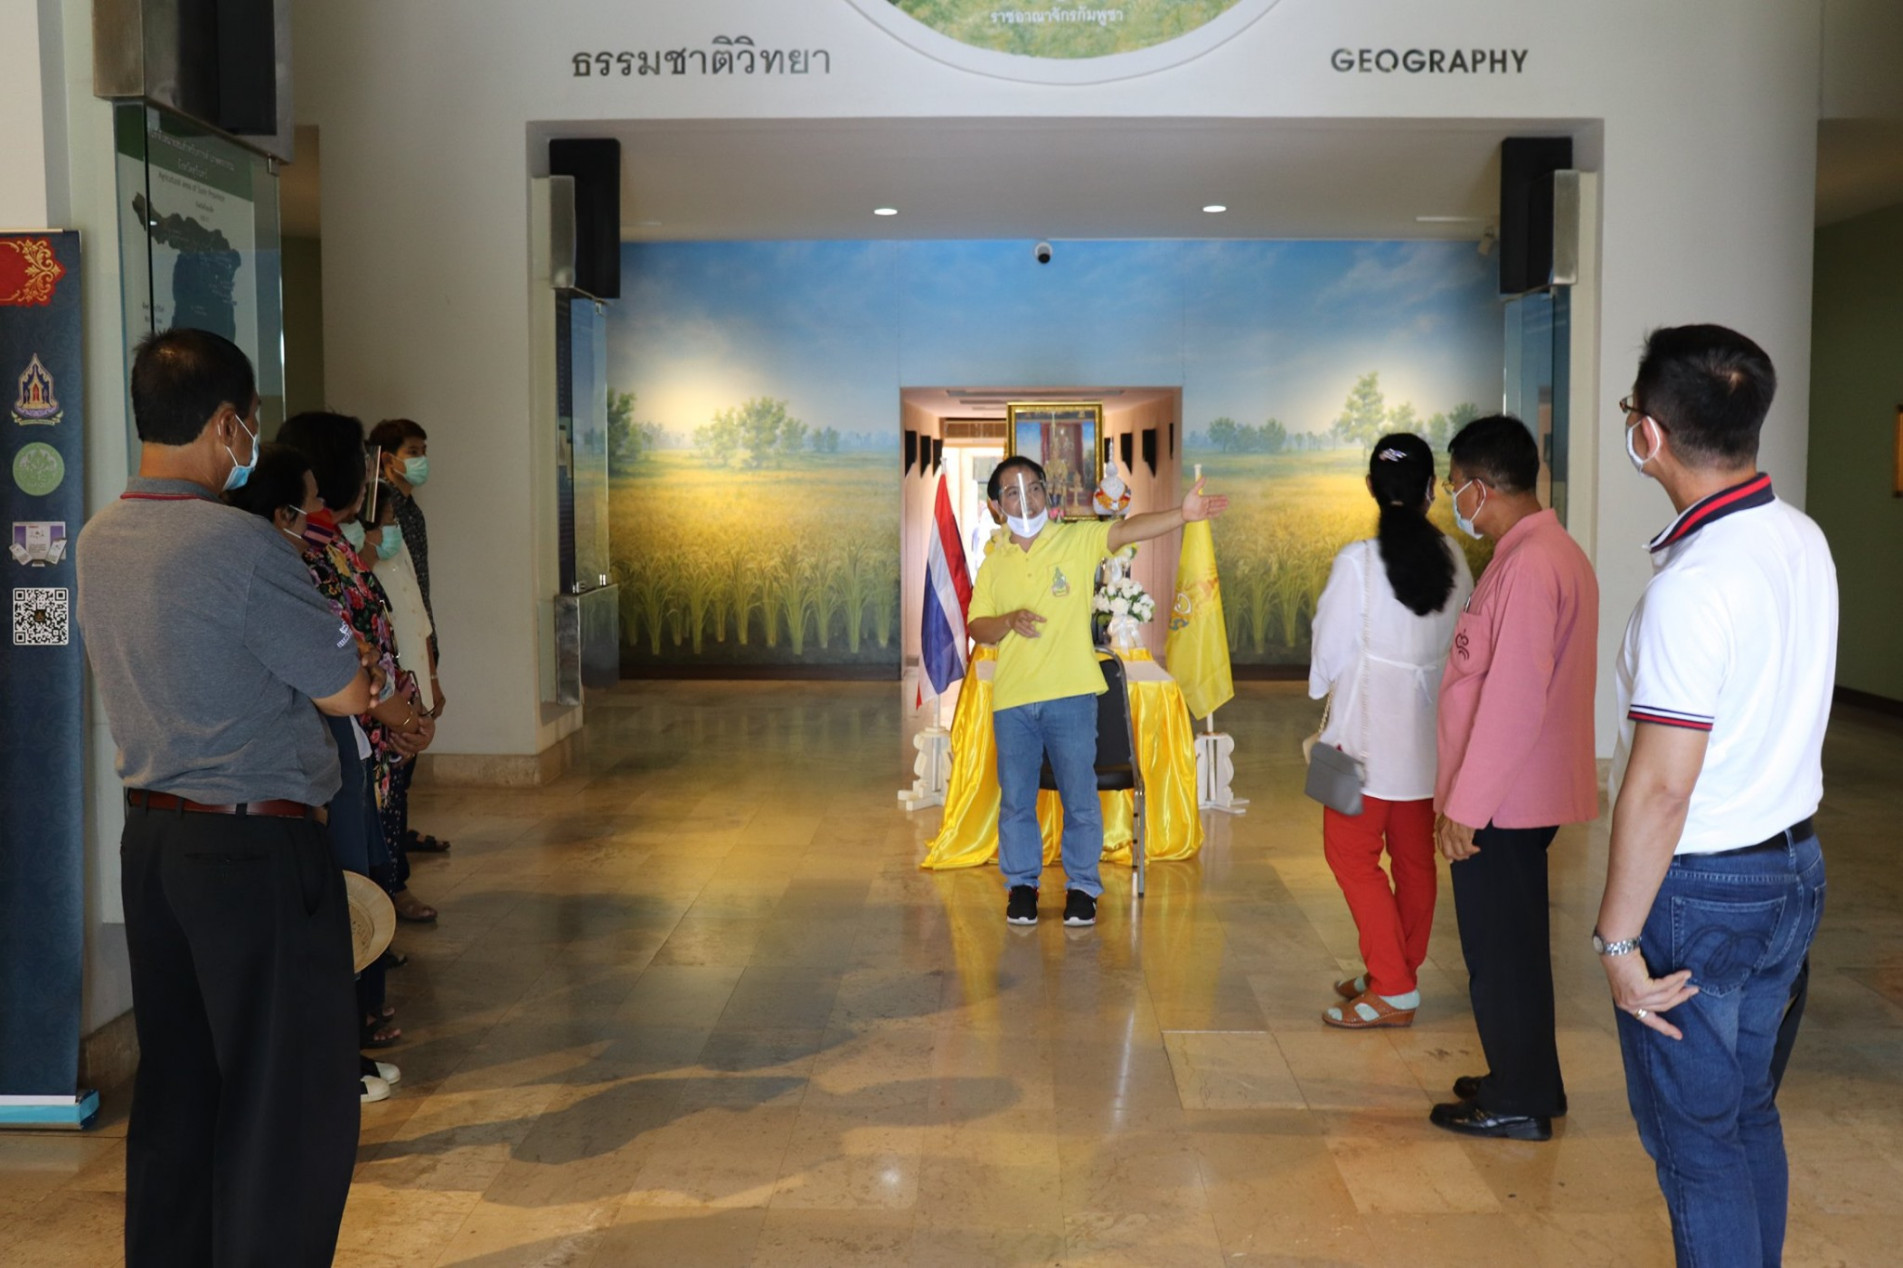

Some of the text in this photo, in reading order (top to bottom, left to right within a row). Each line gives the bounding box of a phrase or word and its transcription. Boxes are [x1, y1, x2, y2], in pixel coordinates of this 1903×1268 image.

[990, 5, 1124, 26] ราชอาณาจักรกัมพูชา
[572, 35, 831, 77] ธรรมชาติวิทยา
[1330, 48, 1529, 74] GEOGRAPHY
